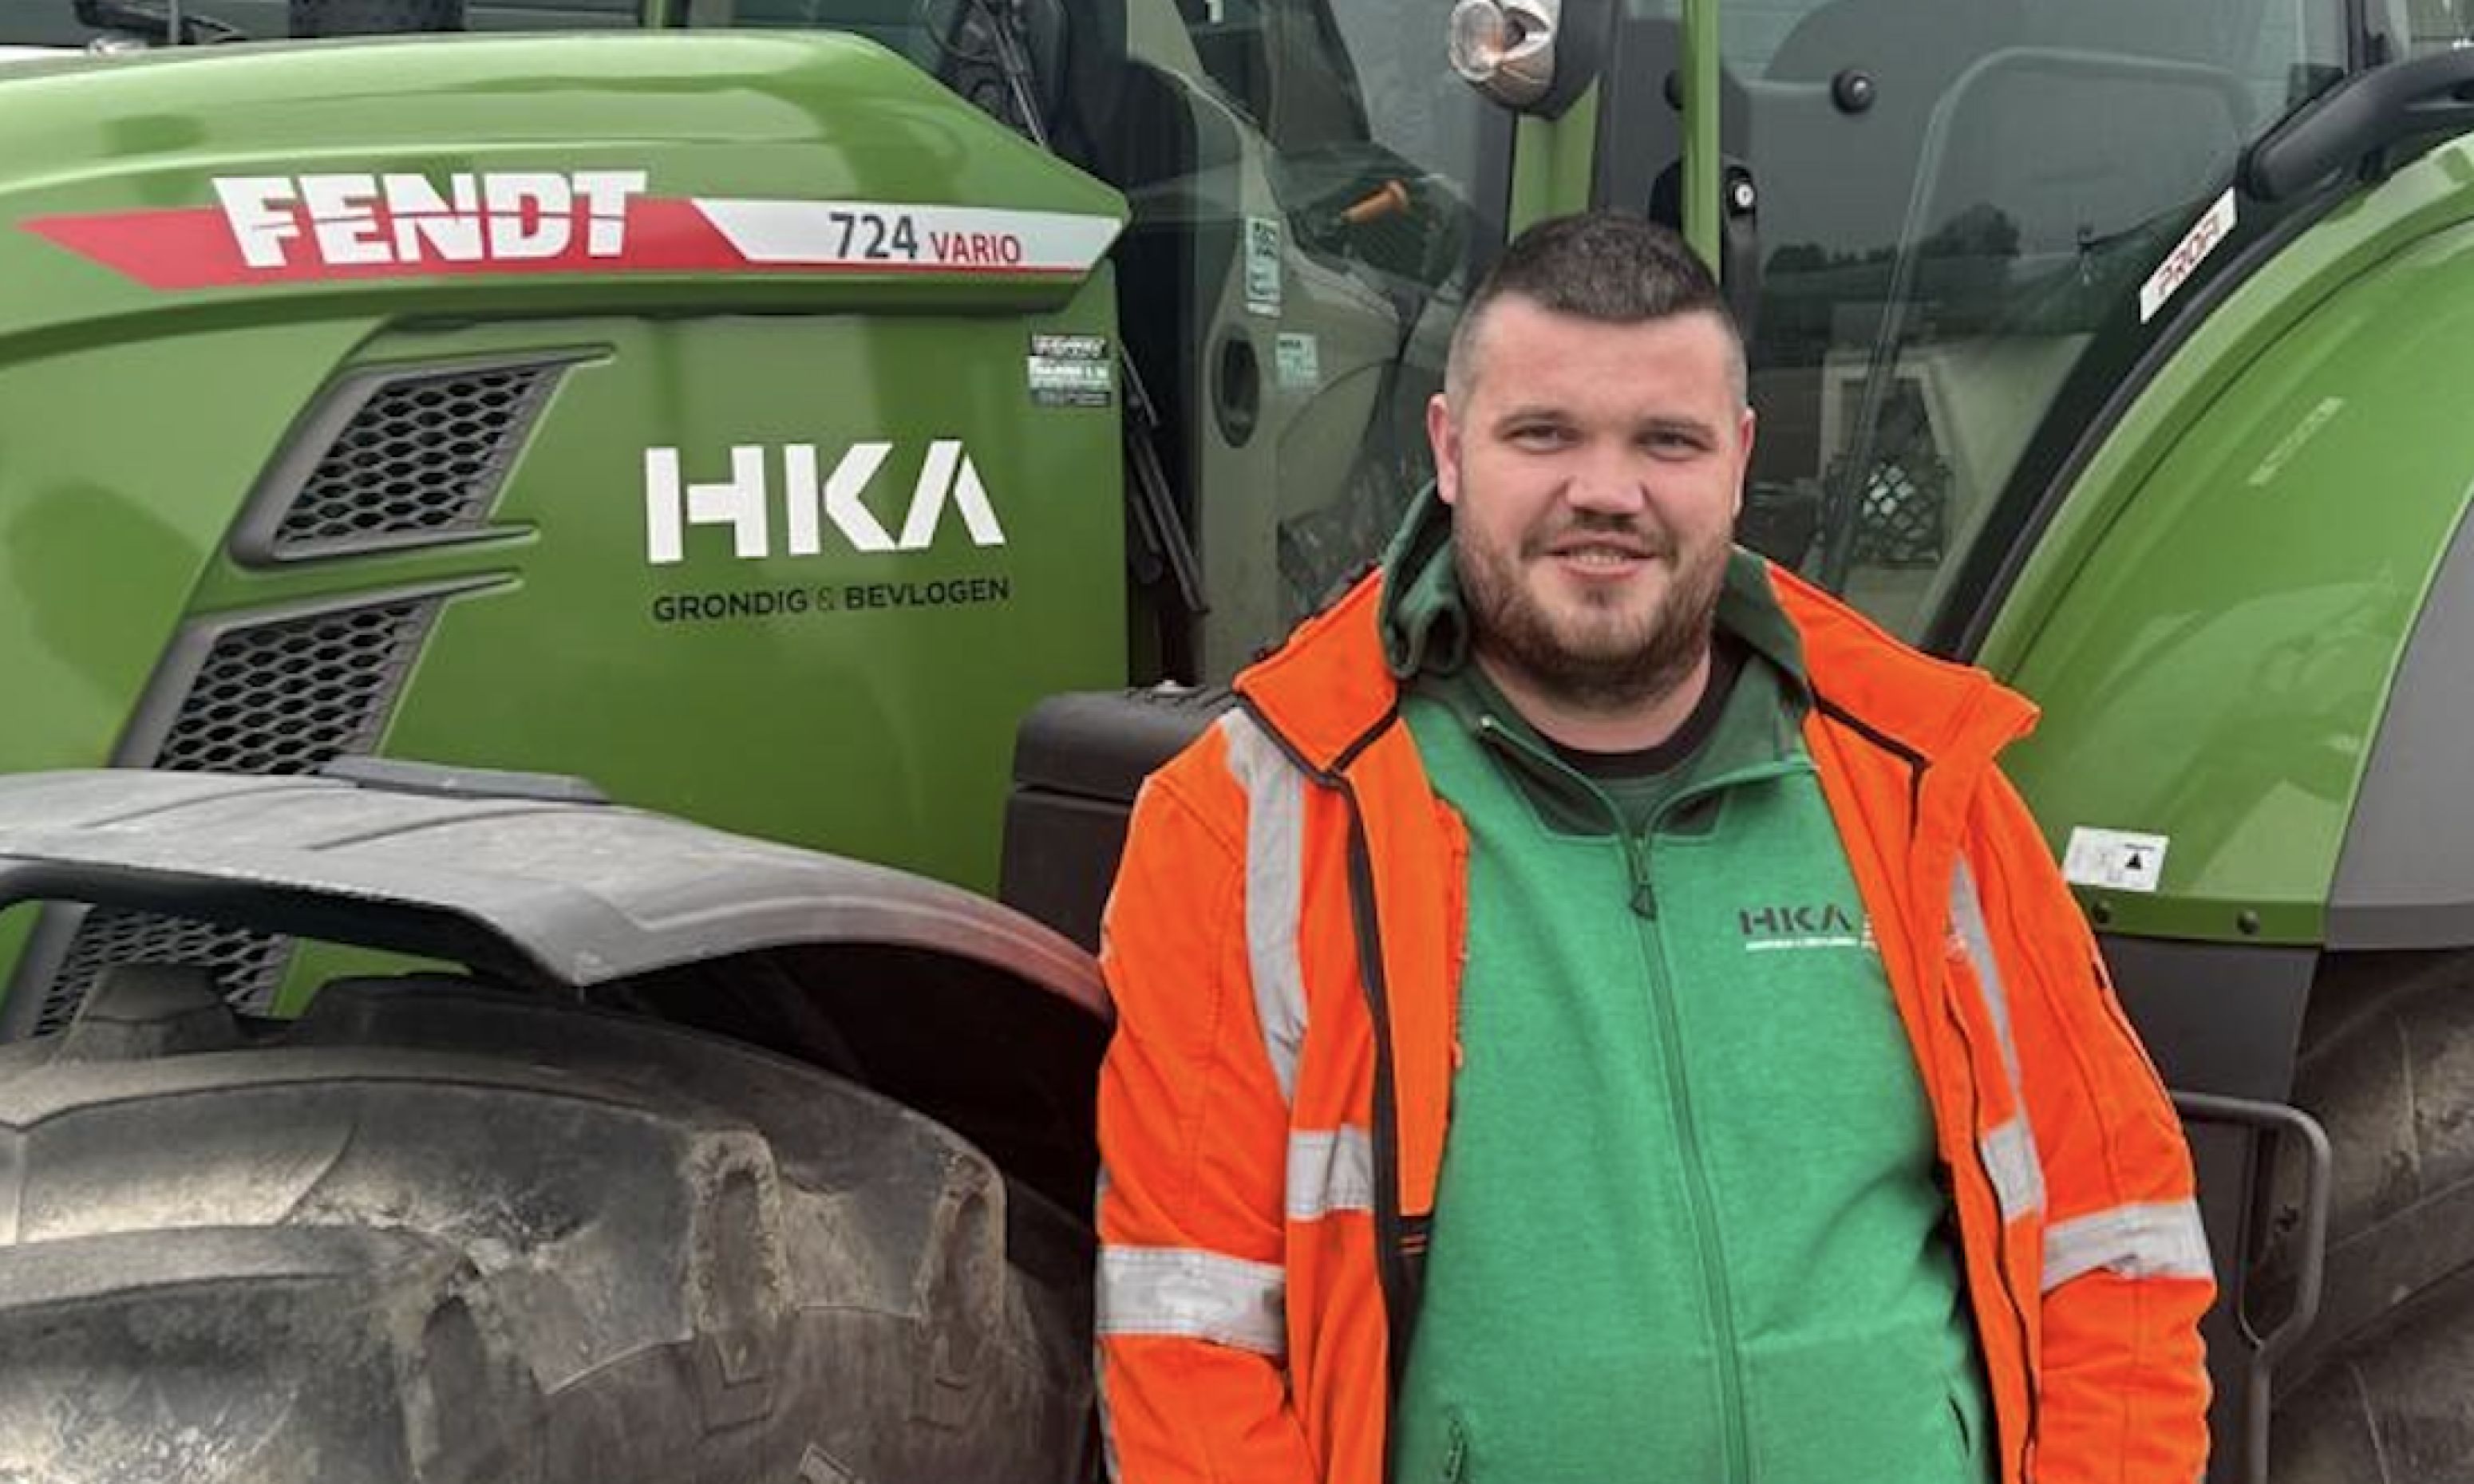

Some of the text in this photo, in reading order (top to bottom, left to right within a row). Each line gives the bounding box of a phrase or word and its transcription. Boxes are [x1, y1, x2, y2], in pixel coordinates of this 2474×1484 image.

[211, 171, 647, 266] FENDT
[829, 211, 1022, 262] 724 VARIO
[646, 440, 1006, 563] HKA
[653, 577, 1010, 622] GRONDIG & BEVLOGEN
[1738, 905, 1852, 935] HKA
